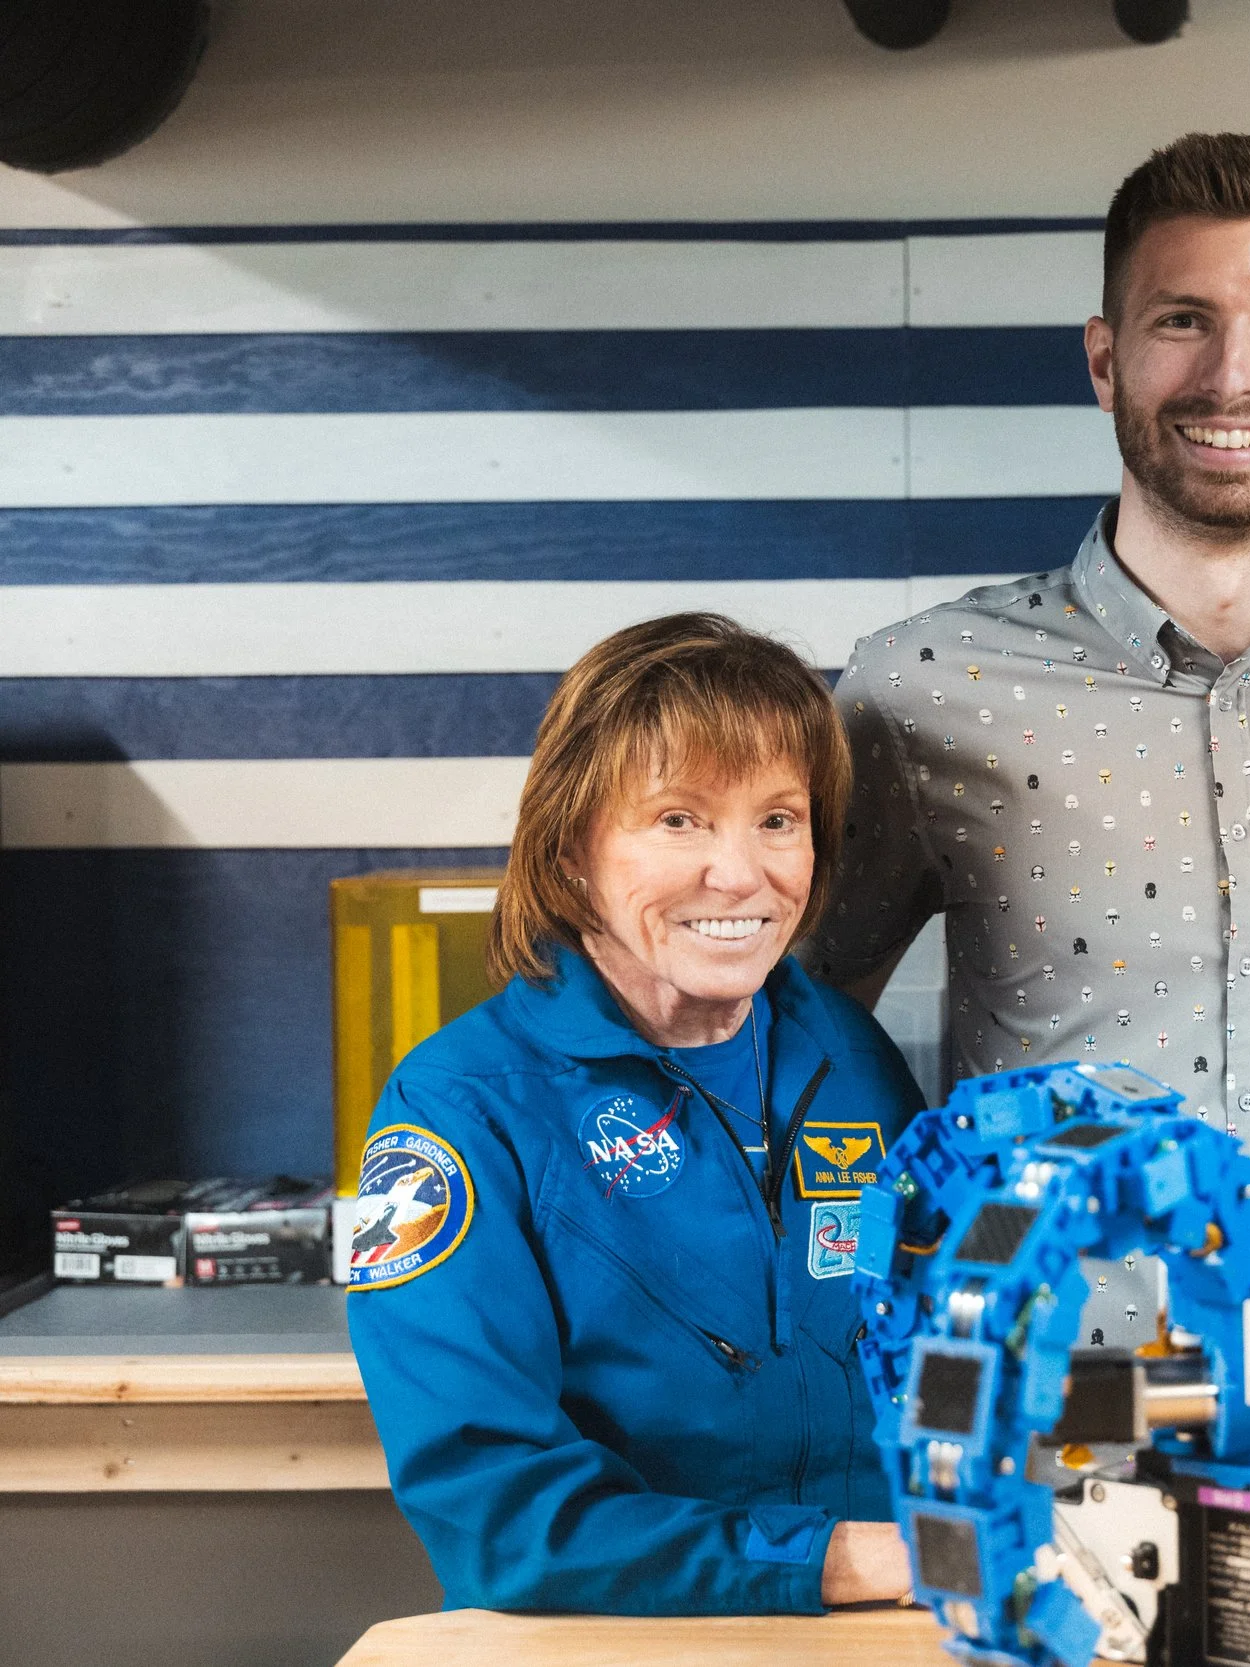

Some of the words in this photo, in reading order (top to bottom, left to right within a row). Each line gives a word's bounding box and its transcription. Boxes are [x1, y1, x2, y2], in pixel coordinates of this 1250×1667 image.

[366, 1135, 399, 1159] FISHER
[406, 1136, 458, 1177] GARDNER
[587, 1128, 680, 1165] NASA
[815, 1171, 836, 1184] ANNA
[837, 1171, 852, 1184] LEE
[852, 1171, 878, 1184] FISHER
[91, 1232, 130, 1248] Gloves
[369, 1252, 423, 1279] WALKER
